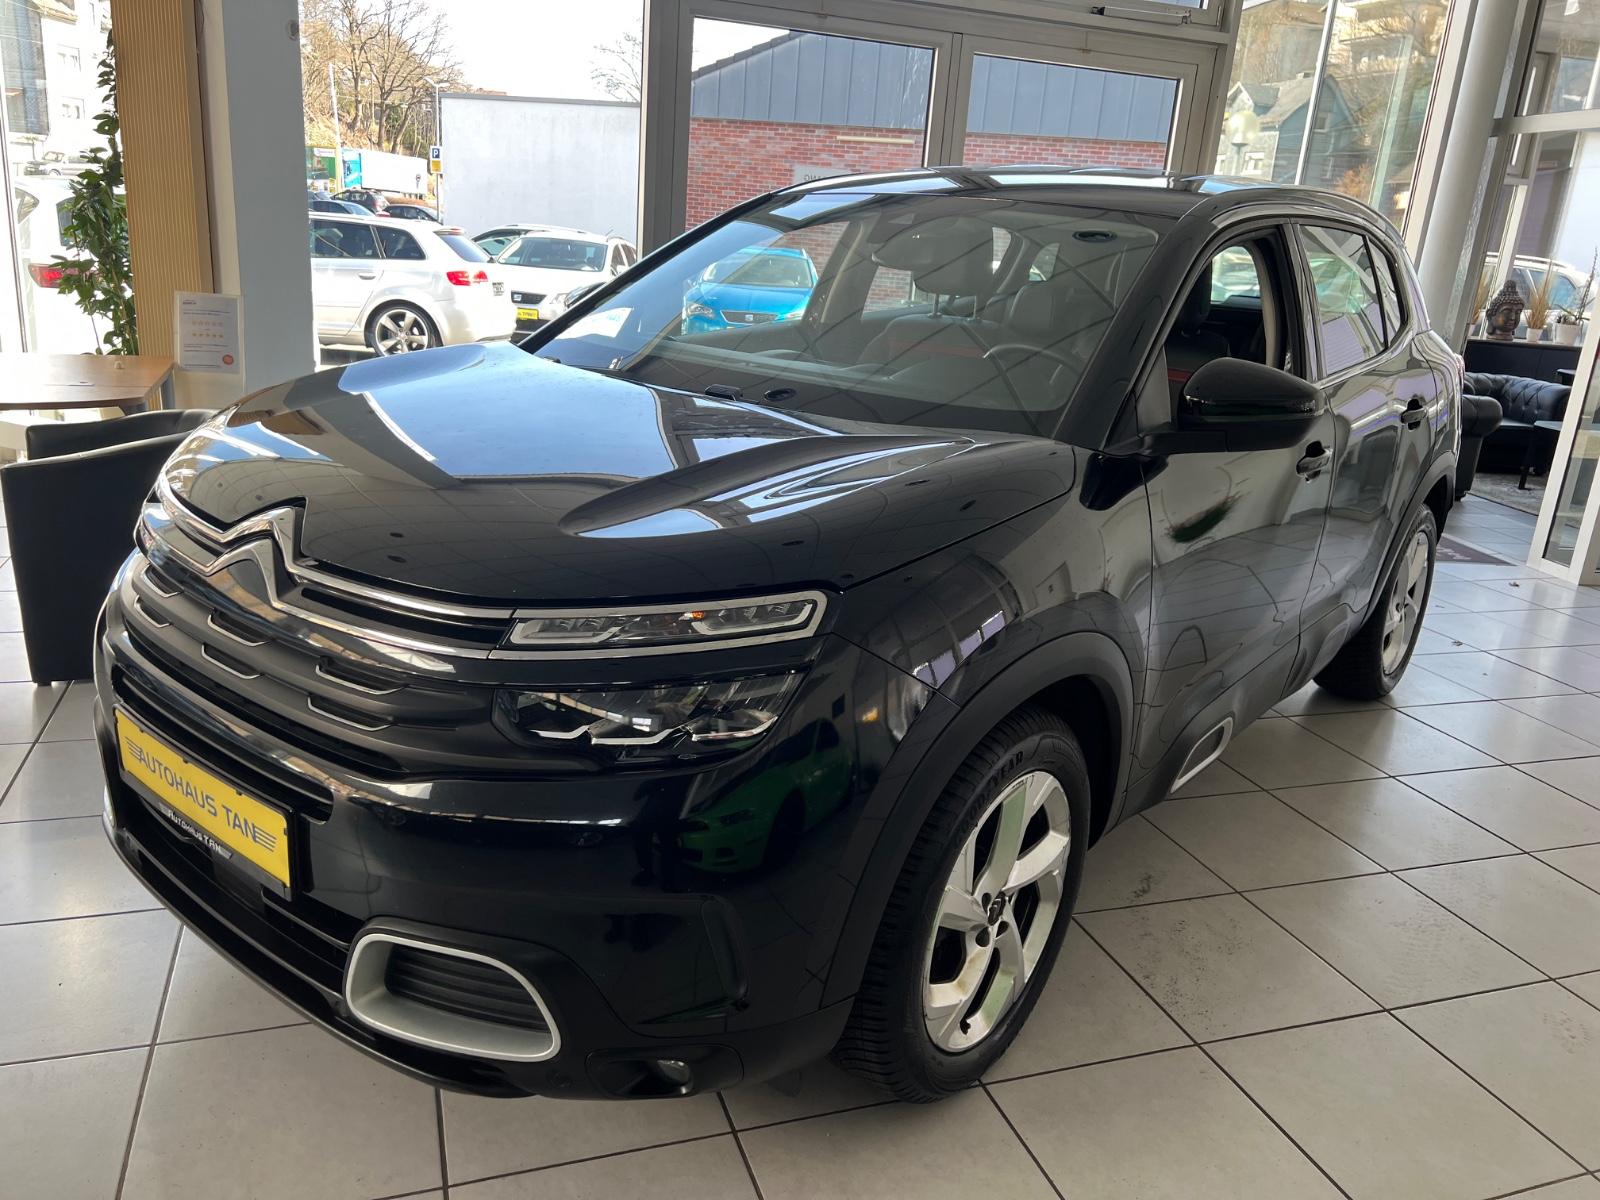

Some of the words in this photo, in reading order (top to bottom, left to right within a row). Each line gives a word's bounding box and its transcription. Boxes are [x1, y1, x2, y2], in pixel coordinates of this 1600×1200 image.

[138, 748, 218, 817] AUTOHAUS
[221, 804, 258, 844] TAN
[203, 834, 221, 852] TAN
